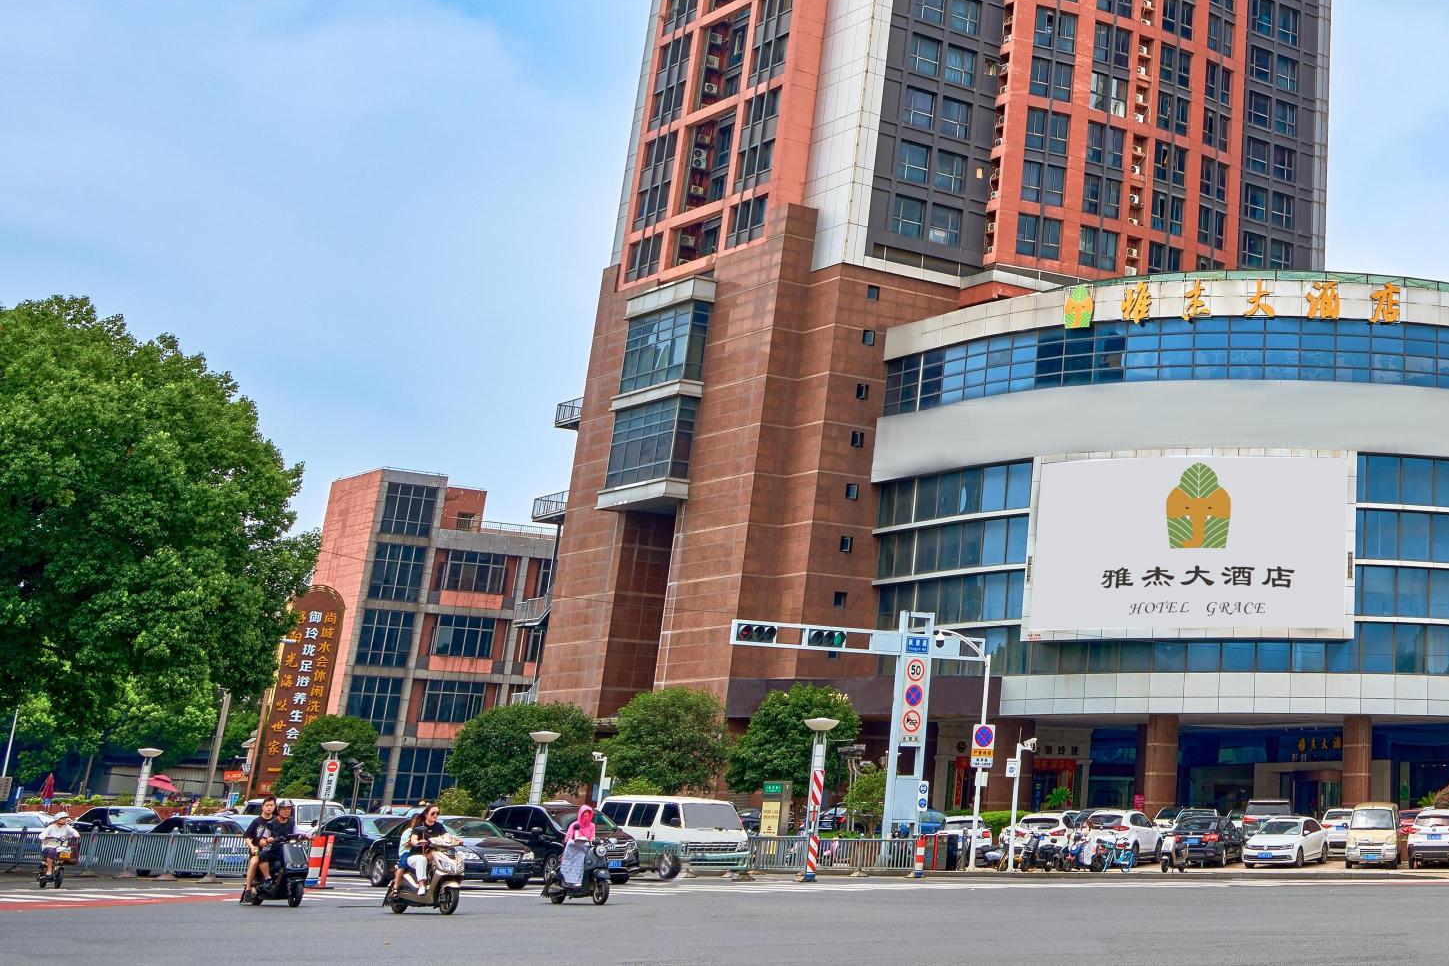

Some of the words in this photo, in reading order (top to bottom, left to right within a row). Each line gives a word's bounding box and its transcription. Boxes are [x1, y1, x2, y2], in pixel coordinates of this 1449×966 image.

[1121, 278, 1401, 324] 雅杰大酒店
[1101, 565, 1295, 589] 雅杰大酒店
[1128, 600, 1190, 616] HOTEL
[1205, 601, 1266, 617] GRACE
[911, 665, 921, 676] 50
